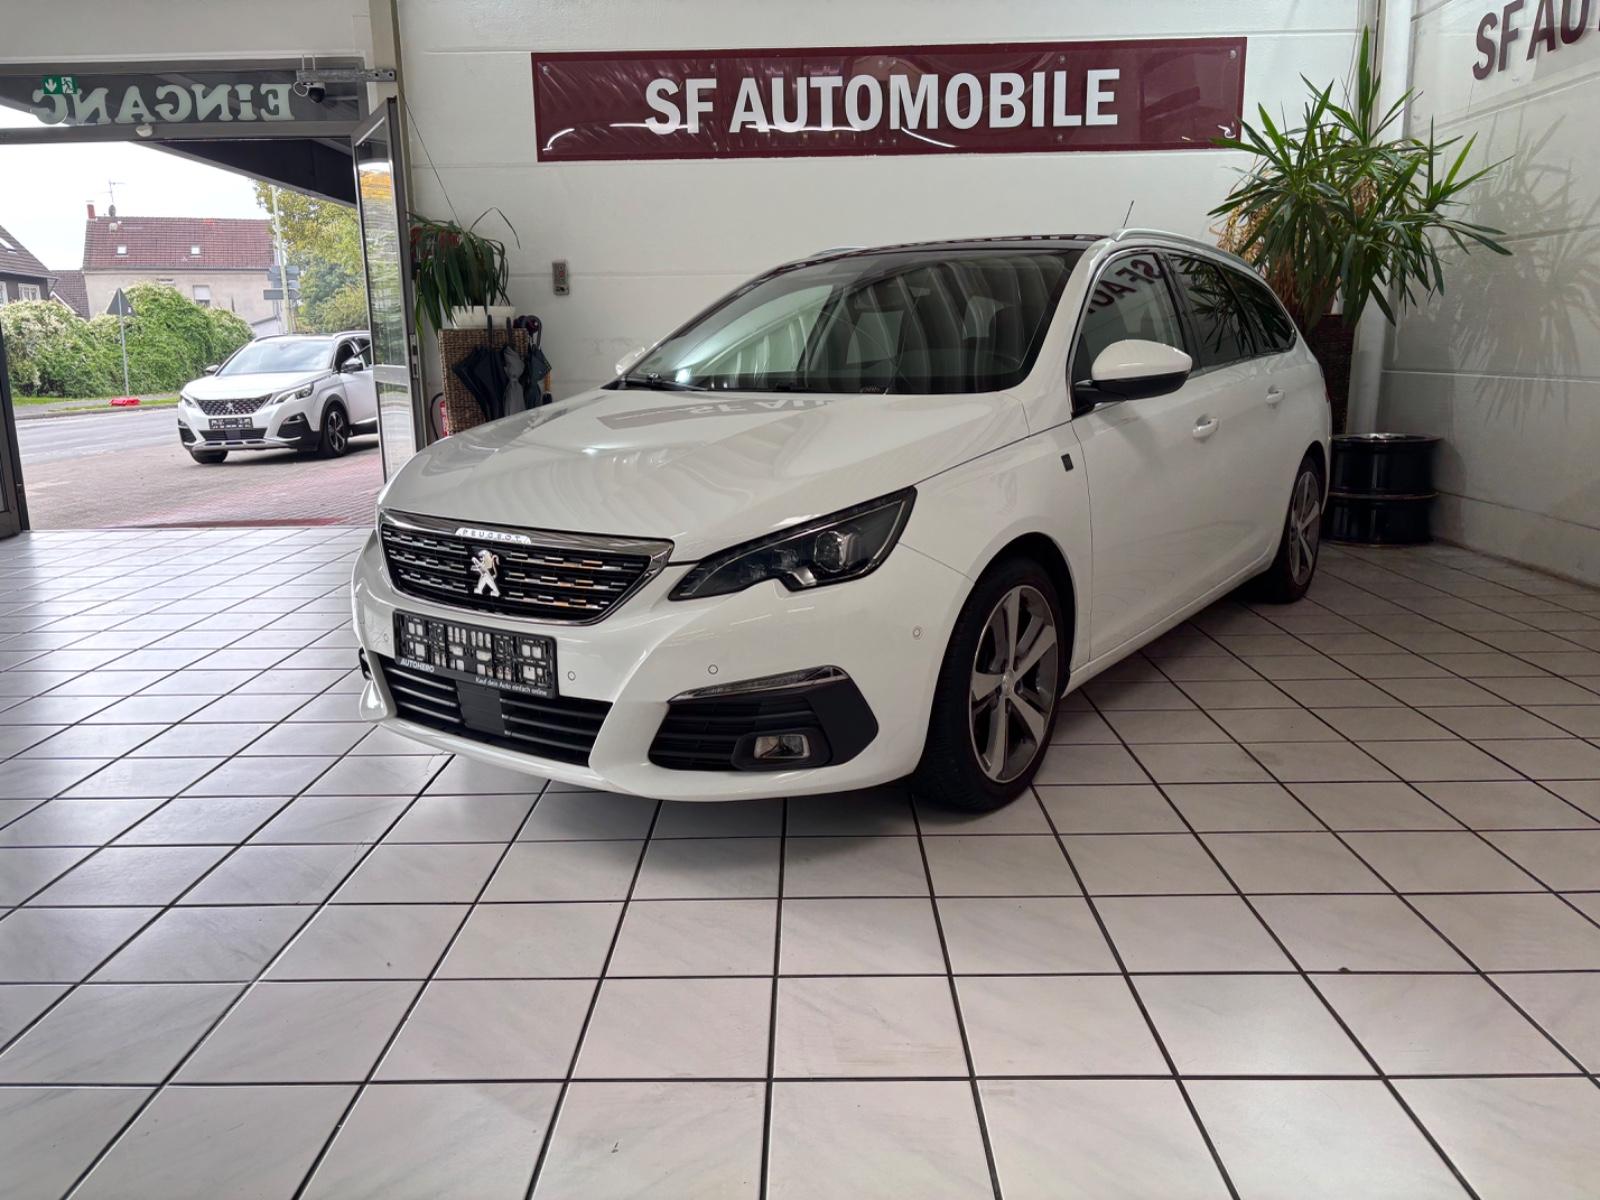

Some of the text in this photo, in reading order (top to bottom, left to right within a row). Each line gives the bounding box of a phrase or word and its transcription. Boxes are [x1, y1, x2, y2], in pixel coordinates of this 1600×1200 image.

[1472, 0, 1600, 81] SF AU
[644, 68, 1120, 136] SF AUTOMOBILE
[462, 529, 521, 542] PEUGEOT
[400, 658, 435, 673] AUTOHERO
[499, 681, 511, 690] Auto
[511, 684, 531, 694] einfach
